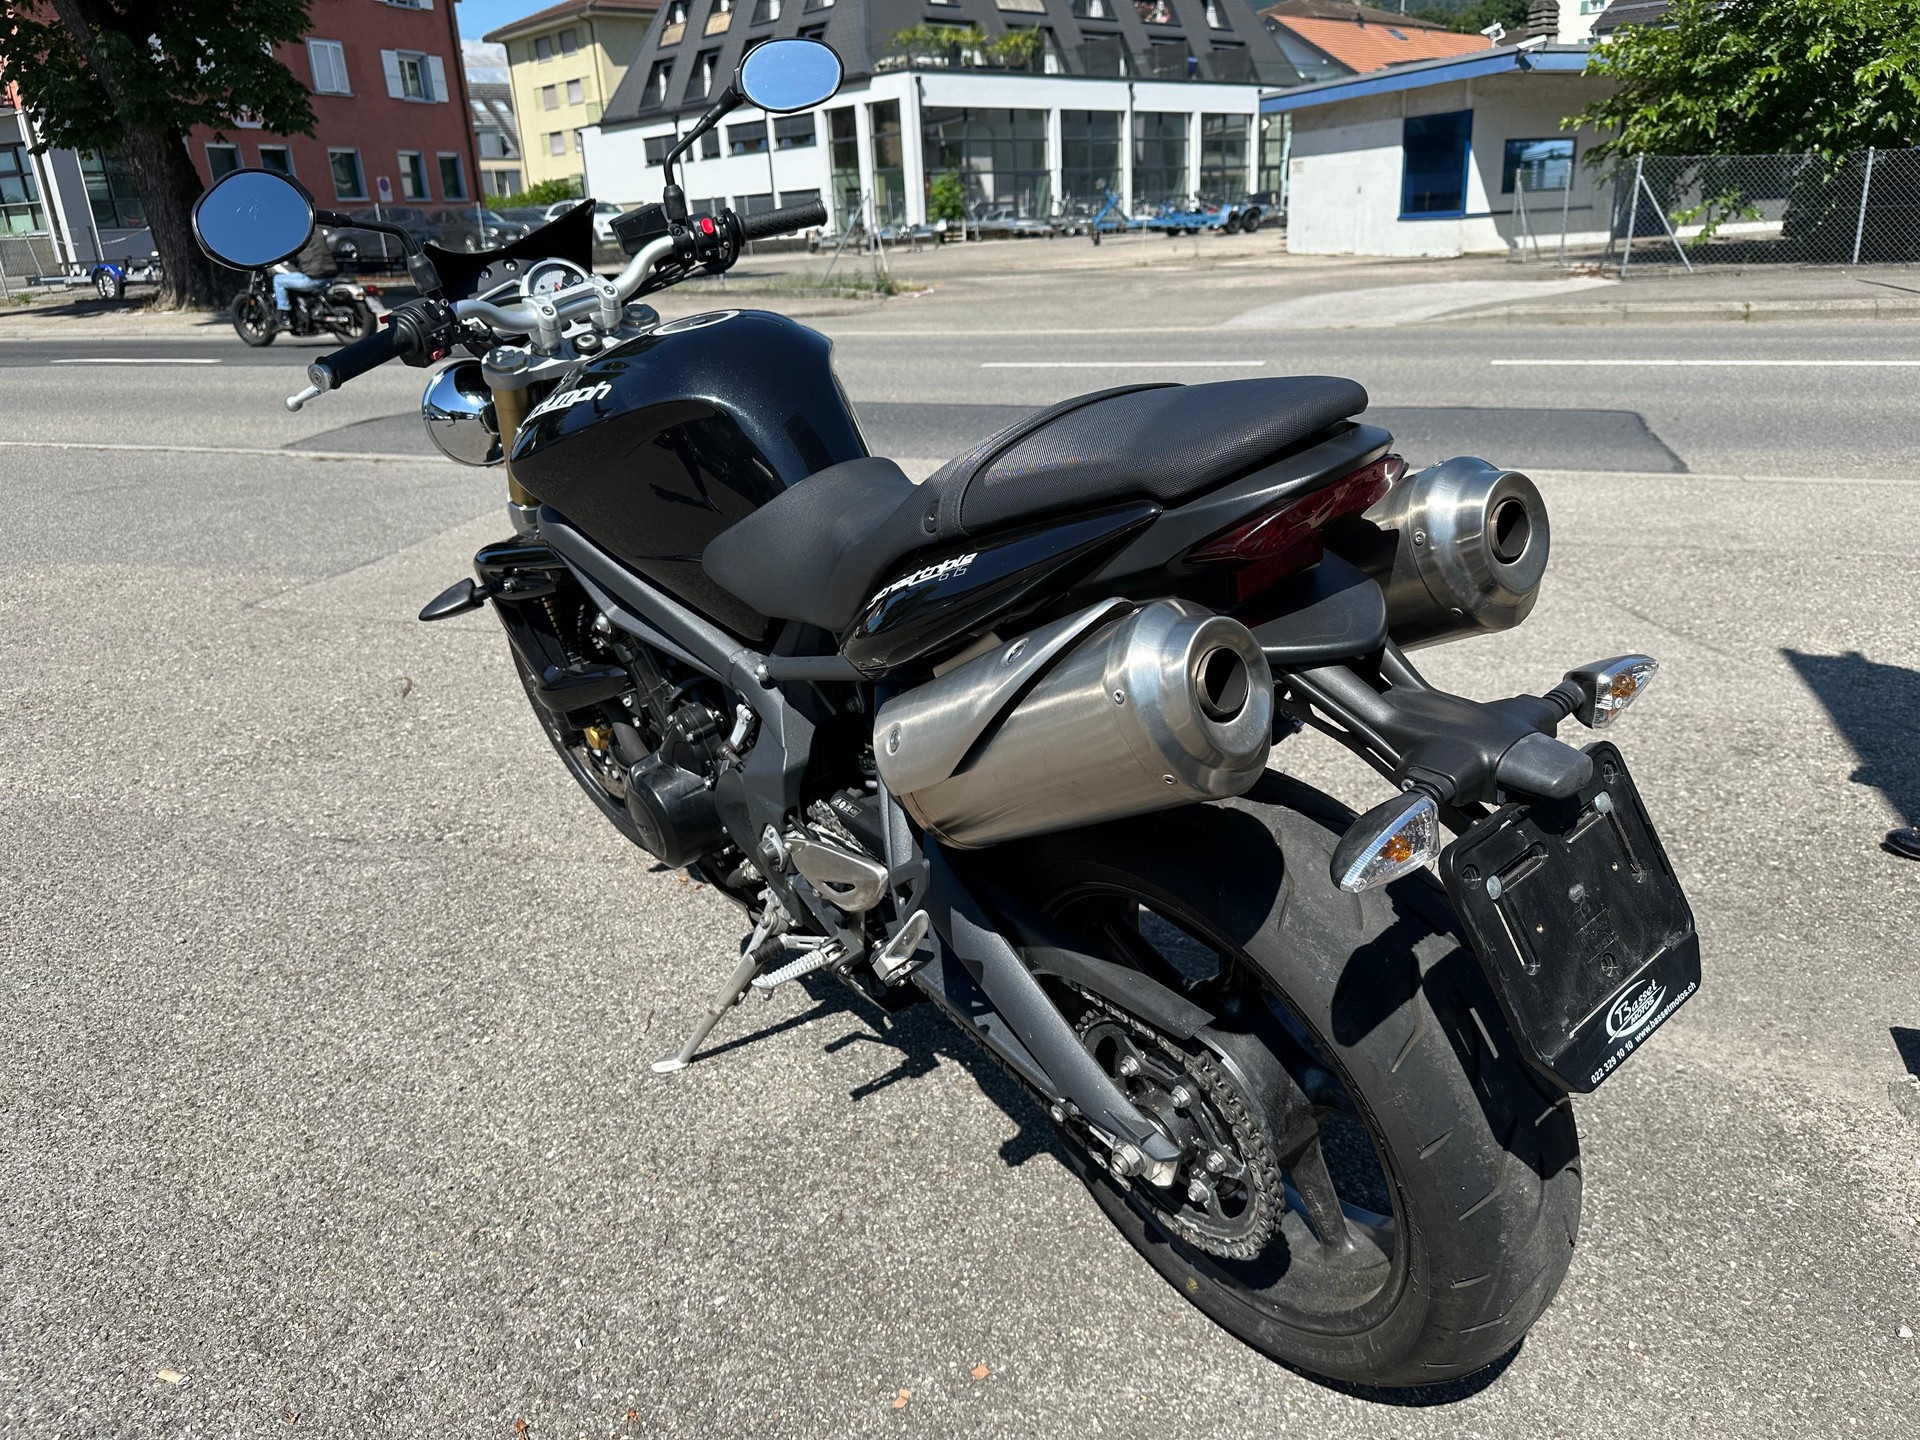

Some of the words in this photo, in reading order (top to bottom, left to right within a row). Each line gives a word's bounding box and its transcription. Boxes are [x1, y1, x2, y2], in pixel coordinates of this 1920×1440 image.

[1590, 1067, 1605, 1084] 022
[1603, 1056, 1617, 1073] 329
[1616, 1048, 1625, 1060] 10
[1624, 1040, 1634, 1052] 10
[1634, 981, 1697, 1043] www.bassetmotos.ch
[1614, 979, 1658, 1026] Basset
